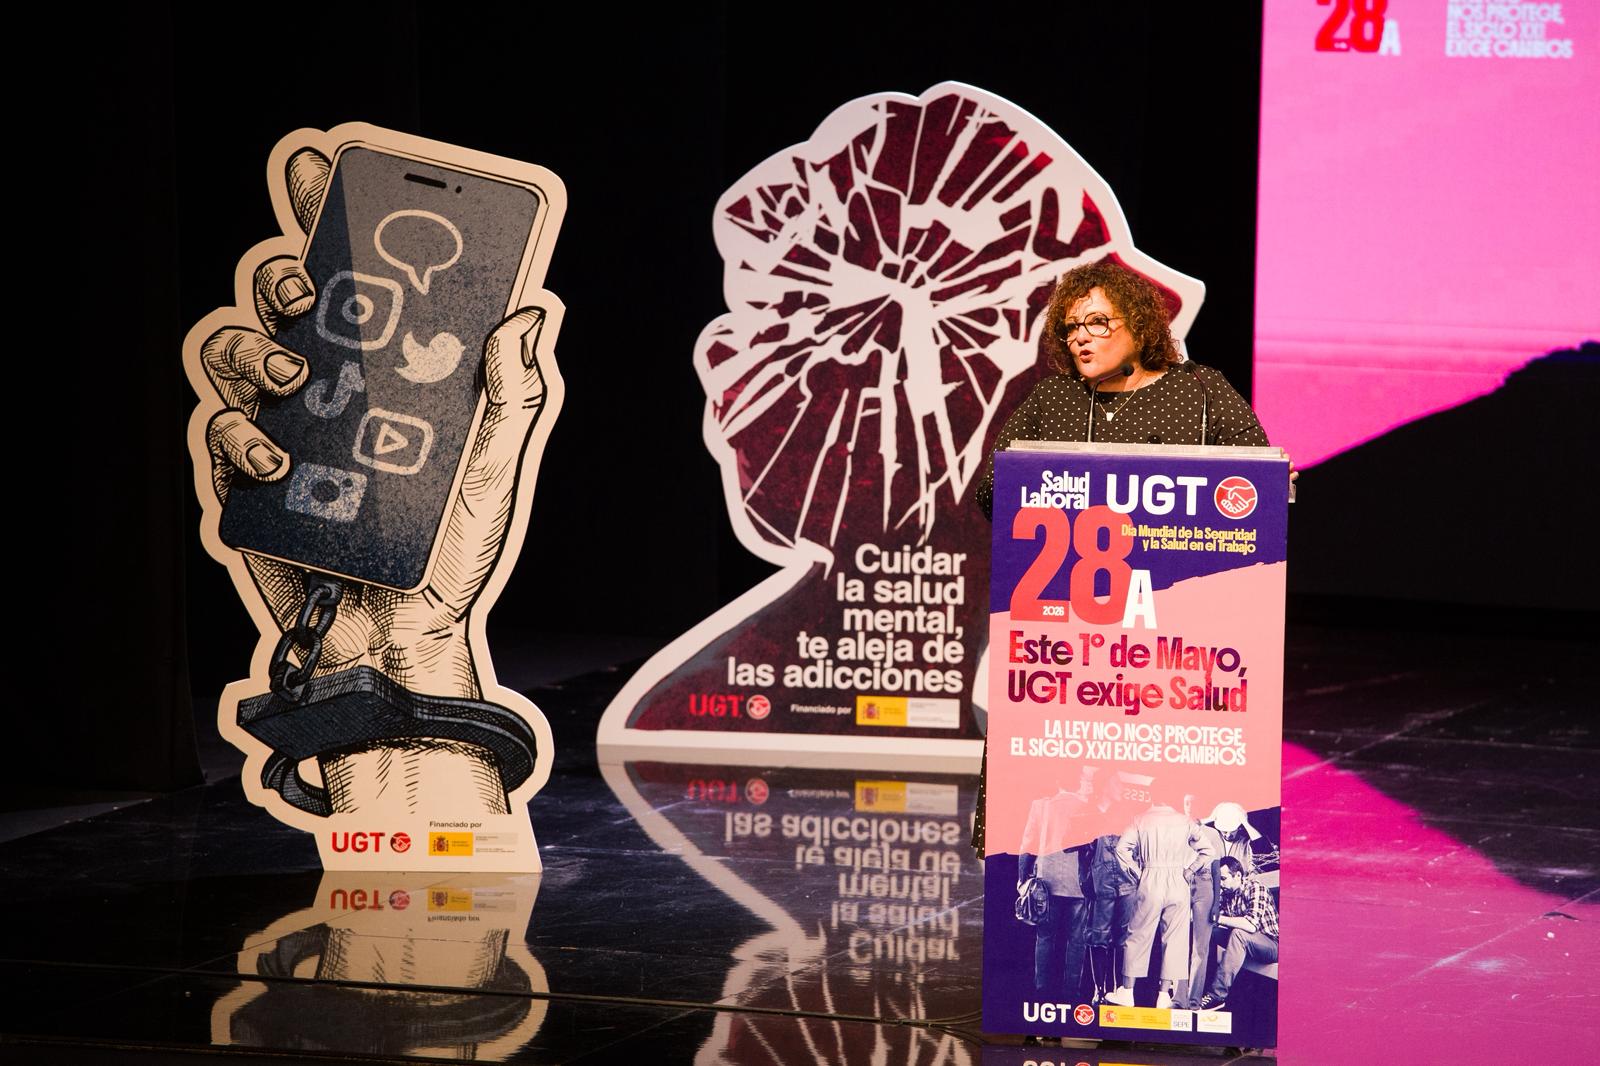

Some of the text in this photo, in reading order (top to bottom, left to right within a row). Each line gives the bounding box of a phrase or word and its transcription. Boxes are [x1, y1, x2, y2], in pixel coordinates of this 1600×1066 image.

[1041, 470, 1090, 493] Salud
[1106, 473, 1207, 516] UGT
[1021, 486, 1089, 509] Laboral
[1138, 525, 1177, 538] Mundial
[1178, 526, 1193, 539] de
[1194, 527, 1203, 539] la
[1205, 527, 1256, 541] Seguridad
[1143, 537, 1256, 555] y la Salud en el Trabajo
[855, 543, 967, 575] Cuidar
[837, 572, 964, 605] la salud
[843, 605, 963, 640] mental,
[1043, 605, 1065, 617] 2026
[797, 631, 964, 668] te aleja de
[1008, 630, 1073, 666] Este
[1110, 635, 1150, 668] de
[1156, 636, 1247, 678] Mayo,
[728, 656, 963, 693] las adicciones
[689, 693, 744, 718] UGT
[1008, 669, 1248, 715] UGT exige Salud
[790, 704, 852, 715] Financiado por
[1044, 719, 1246, 749] LA LEY NO NOS PROTEGE,
[1010, 737, 1246, 766] EL SIGLO XXI EXIGE CAMBIOS
[429, 820, 468, 828] Financiado
[332, 832, 385, 853] UGT
[1023, 1002, 1071, 1024] UGT
